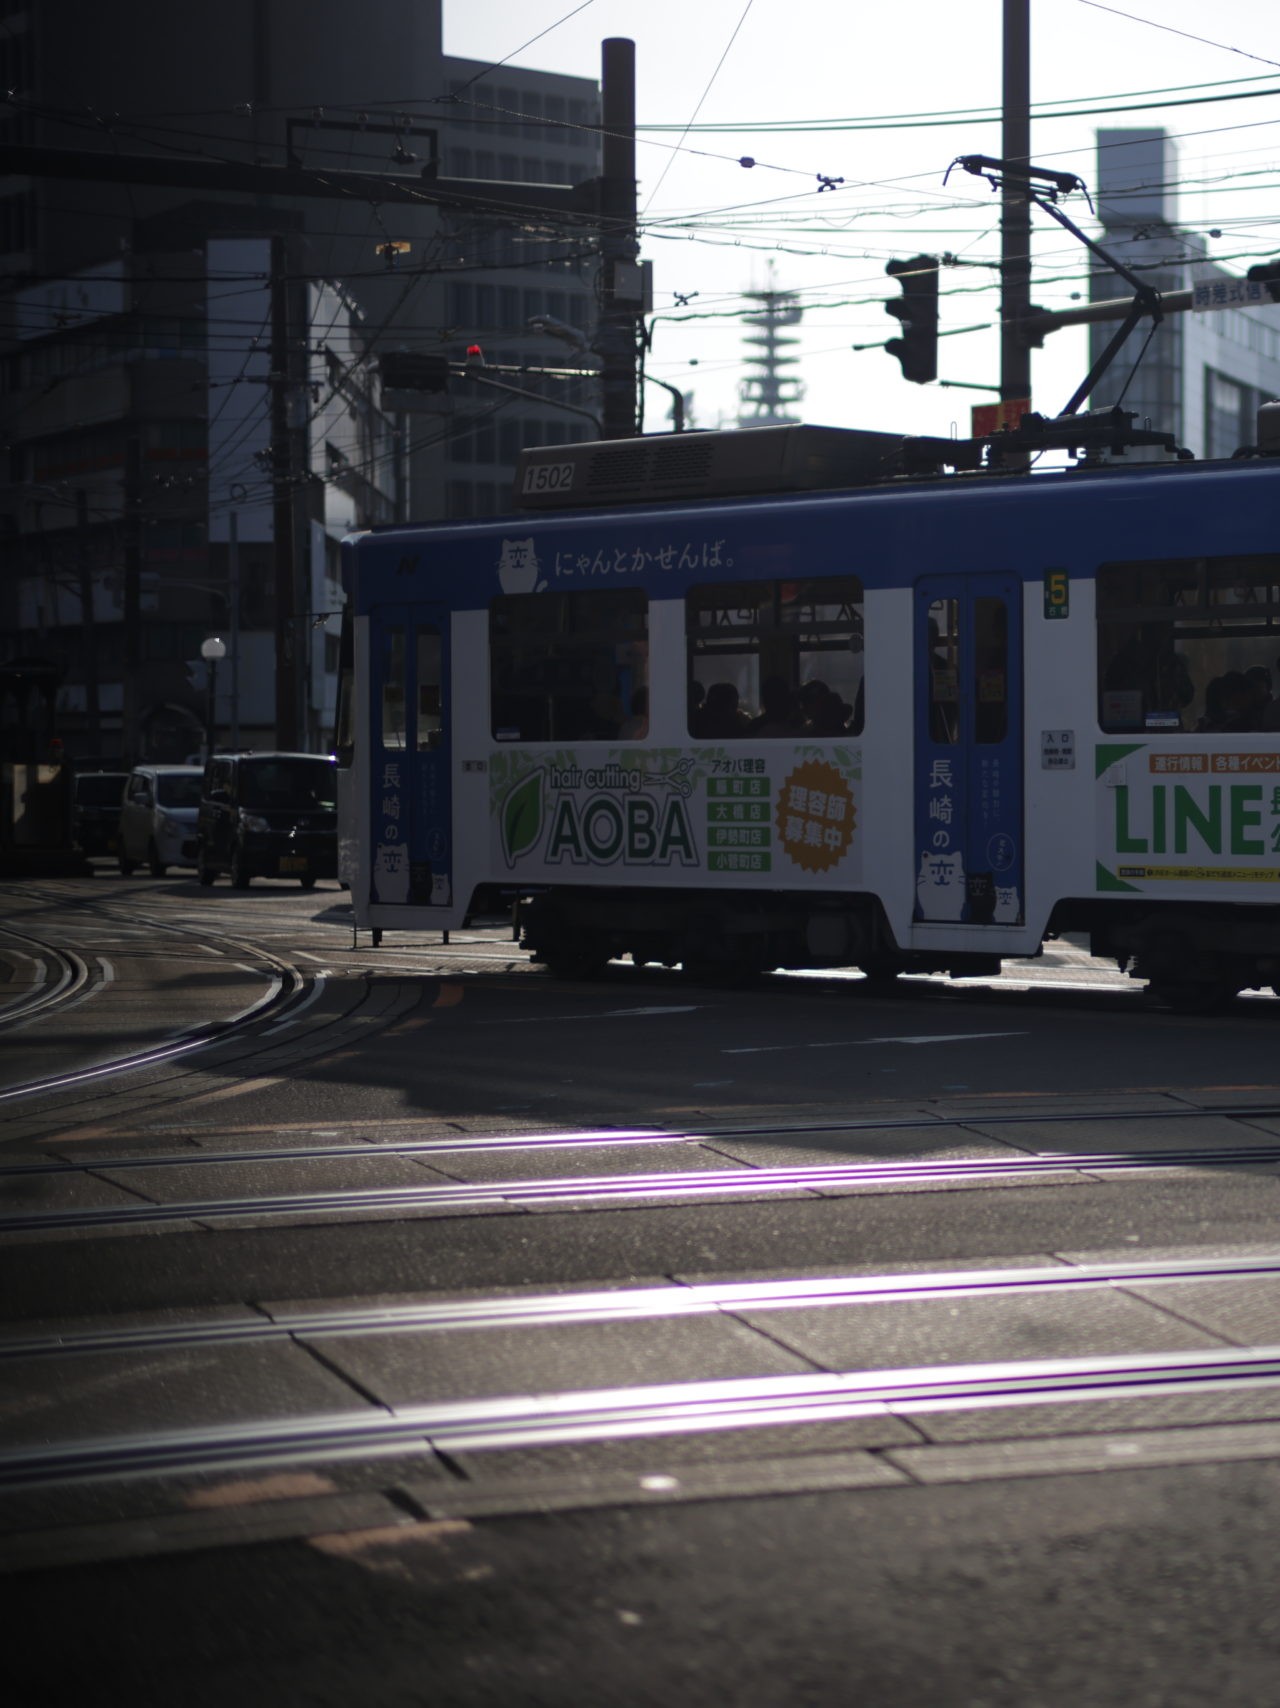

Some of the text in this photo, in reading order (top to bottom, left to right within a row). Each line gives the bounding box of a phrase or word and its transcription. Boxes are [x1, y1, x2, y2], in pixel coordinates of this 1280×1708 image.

[527, 465, 572, 490] 1502
[555, 540, 735, 577] にゃんとかせんば。
[1049, 574, 1067, 606] 5
[550, 765, 642, 792] hair cutting
[711, 758, 766, 774] アオバ理容
[545, 793, 698, 867] AOBA
[1116, 785, 1265, 855] LINE
